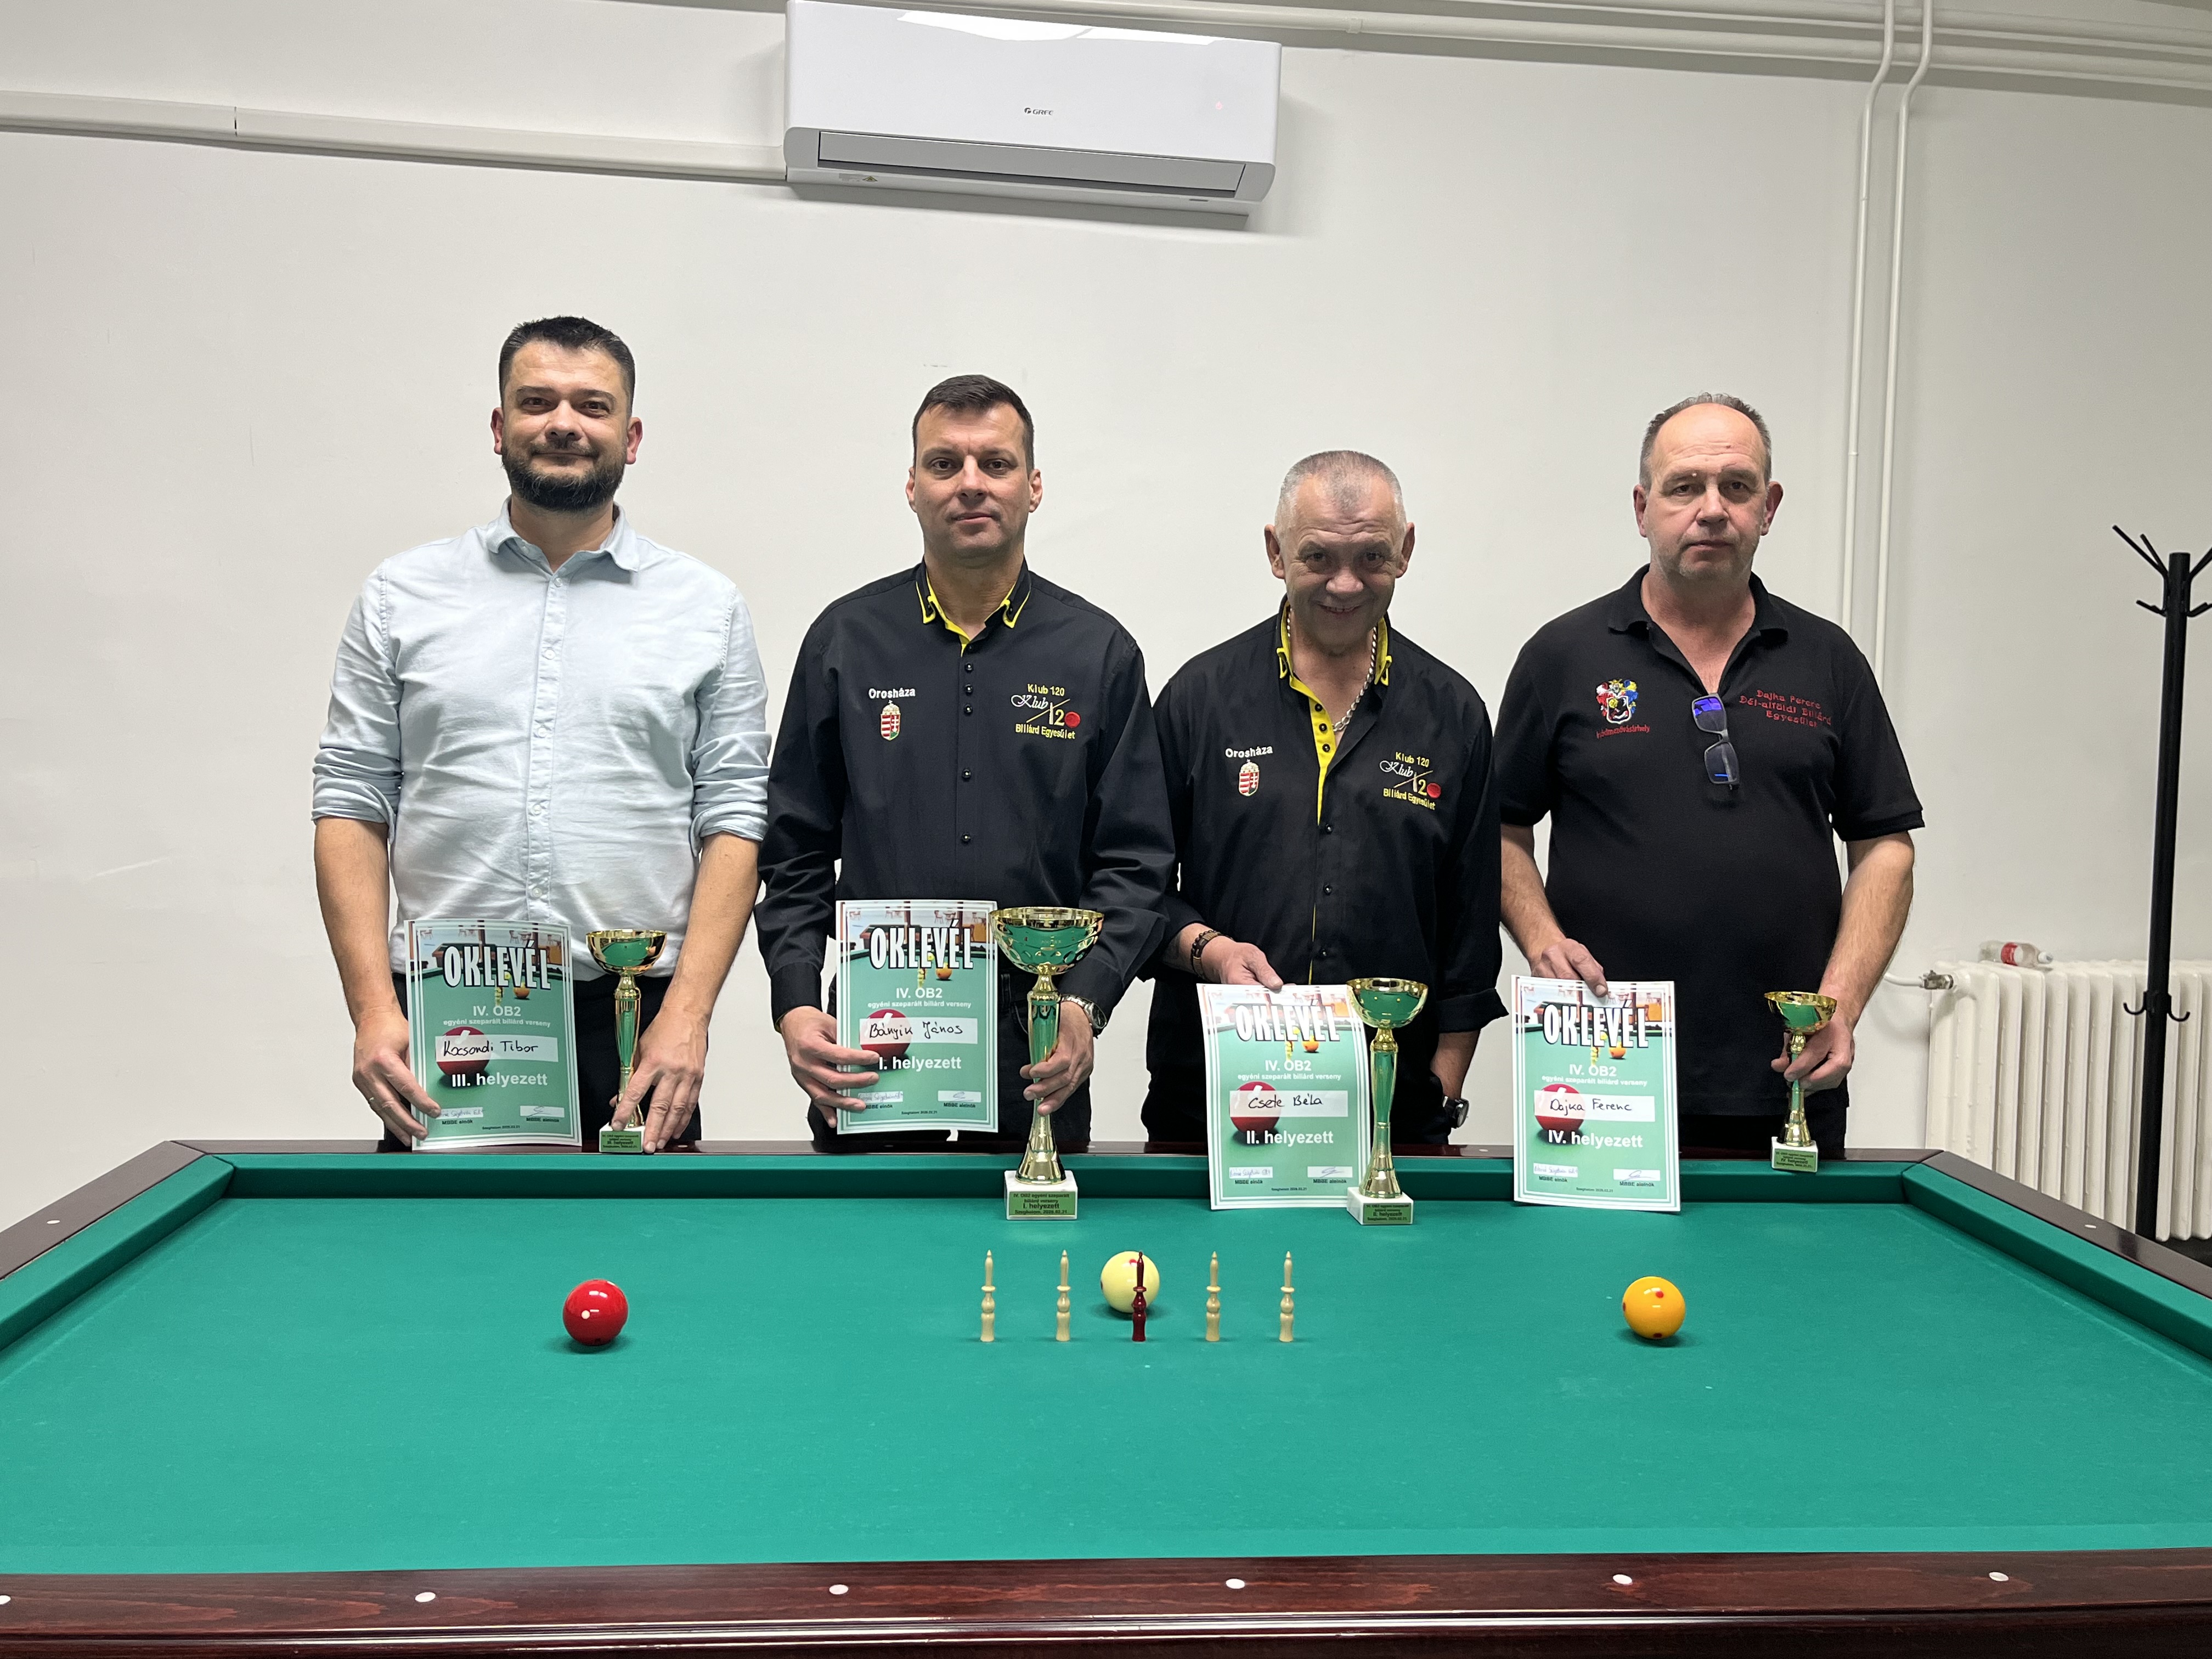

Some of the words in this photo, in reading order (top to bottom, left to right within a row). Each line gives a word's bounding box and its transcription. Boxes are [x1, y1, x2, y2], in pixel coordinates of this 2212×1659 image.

[868, 687, 916, 699] Orosháza
[1028, 684, 1048, 695] Klub
[1049, 686, 1065, 697] 120
[1011, 695, 1048, 710] Klub
[1225, 746, 1273, 758] Orosháza
[1396, 752, 1414, 764] Klub
[1417, 756, 1430, 768] 120
[1379, 760, 1414, 777] Klub
[870, 918, 973, 969] OKLEVÉL
[443, 940, 551, 990] OKLEVÉL
[896, 988, 911, 998] IV.
[915, 988, 943, 998] OB2
[473, 1006, 488, 1016] IV.
[493, 1006, 521, 1017] OB2
[1235, 999, 1340, 1042] OKLEVÉL
[1543, 1000, 1649, 1048] OKLEVÉL
[922, 1022, 963, 1039] János
[500, 1040, 538, 1052] Tibor
[879, 1057, 887, 1070] I.
[893, 1056, 961, 1071] helyezett
[1265, 1060, 1280, 1071] IV.
[1284, 1060, 1312, 1071] OB2
[1569, 1064, 1584, 1075] IV.
[1588, 1065, 1617, 1077] OB2
[452, 1074, 471, 1087] III.
[476, 1072, 548, 1087] helyezett
[1248, 1094, 1285, 1108] Csete
[1293, 1093, 1323, 1106] Béla
[1550, 1098, 1585, 1116] Dajka
[1592, 1098, 1633, 1111] Ferenc
[1246, 1130, 1260, 1144] II.
[1265, 1130, 1334, 1147] helyezett
[1548, 1130, 1567, 1144] IV.
[1571, 1131, 1643, 1149] helyezett
